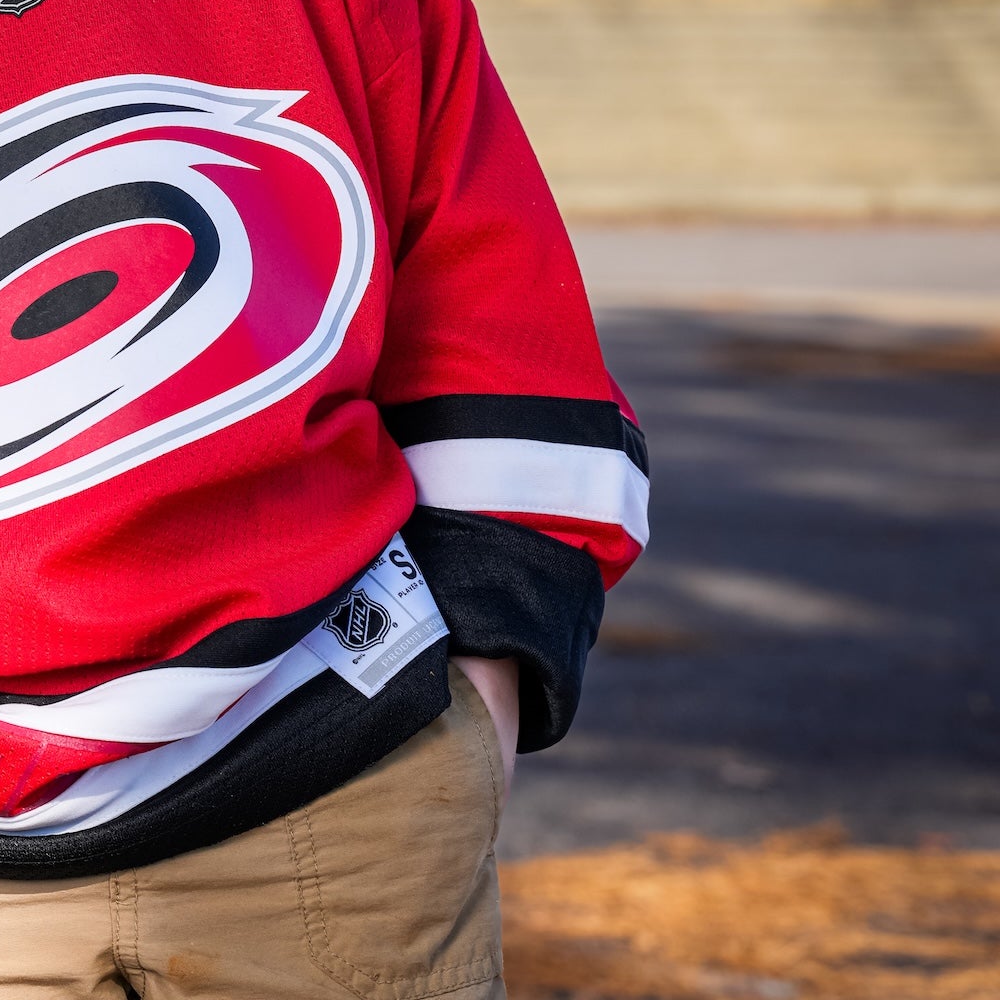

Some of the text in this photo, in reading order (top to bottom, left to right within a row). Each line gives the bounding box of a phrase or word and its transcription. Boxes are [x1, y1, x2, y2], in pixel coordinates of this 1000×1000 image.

[388, 549, 417, 580] S
[398, 582, 419, 599] PLAYER
[351, 603, 367, 642] NHL
[381, 631, 423, 668] PRODUIT
